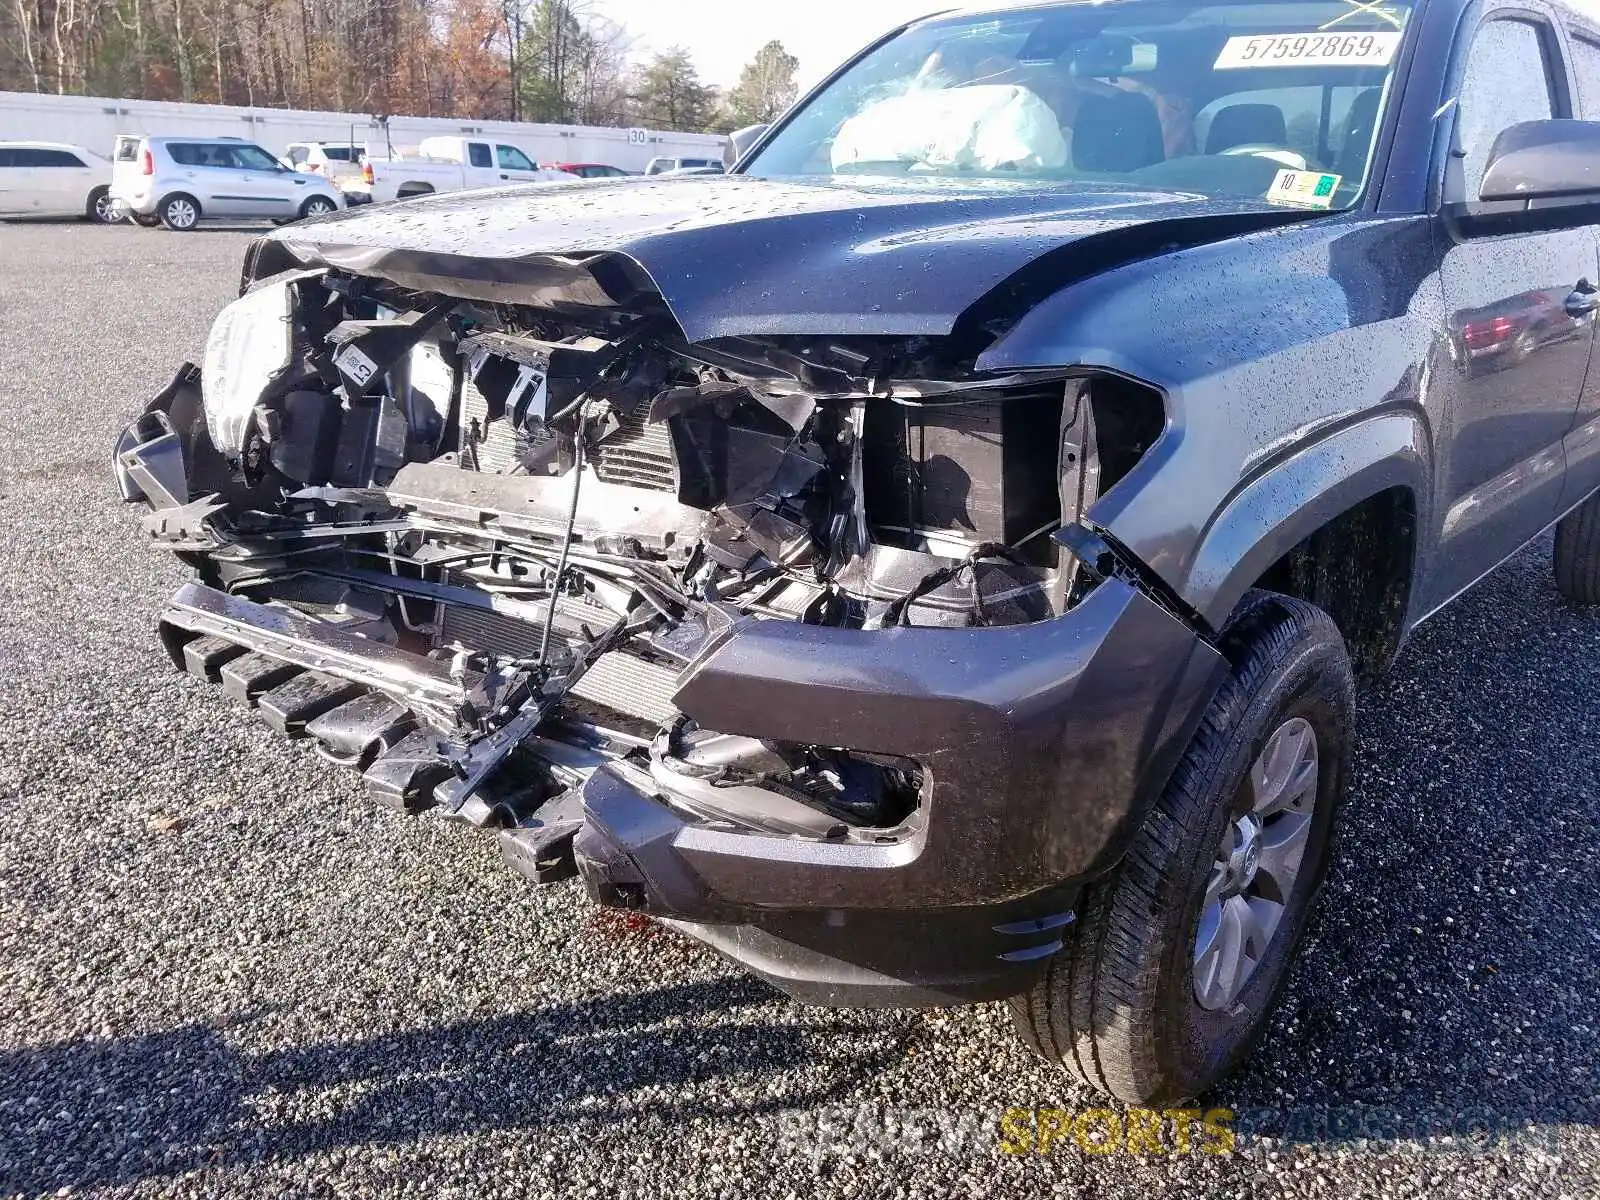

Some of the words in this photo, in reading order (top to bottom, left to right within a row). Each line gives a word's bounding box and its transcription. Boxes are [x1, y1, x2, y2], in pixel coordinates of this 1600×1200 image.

[631, 130, 645, 143] 30
[1280, 173, 1296, 191] 10
[353, 365, 371, 383] C1
